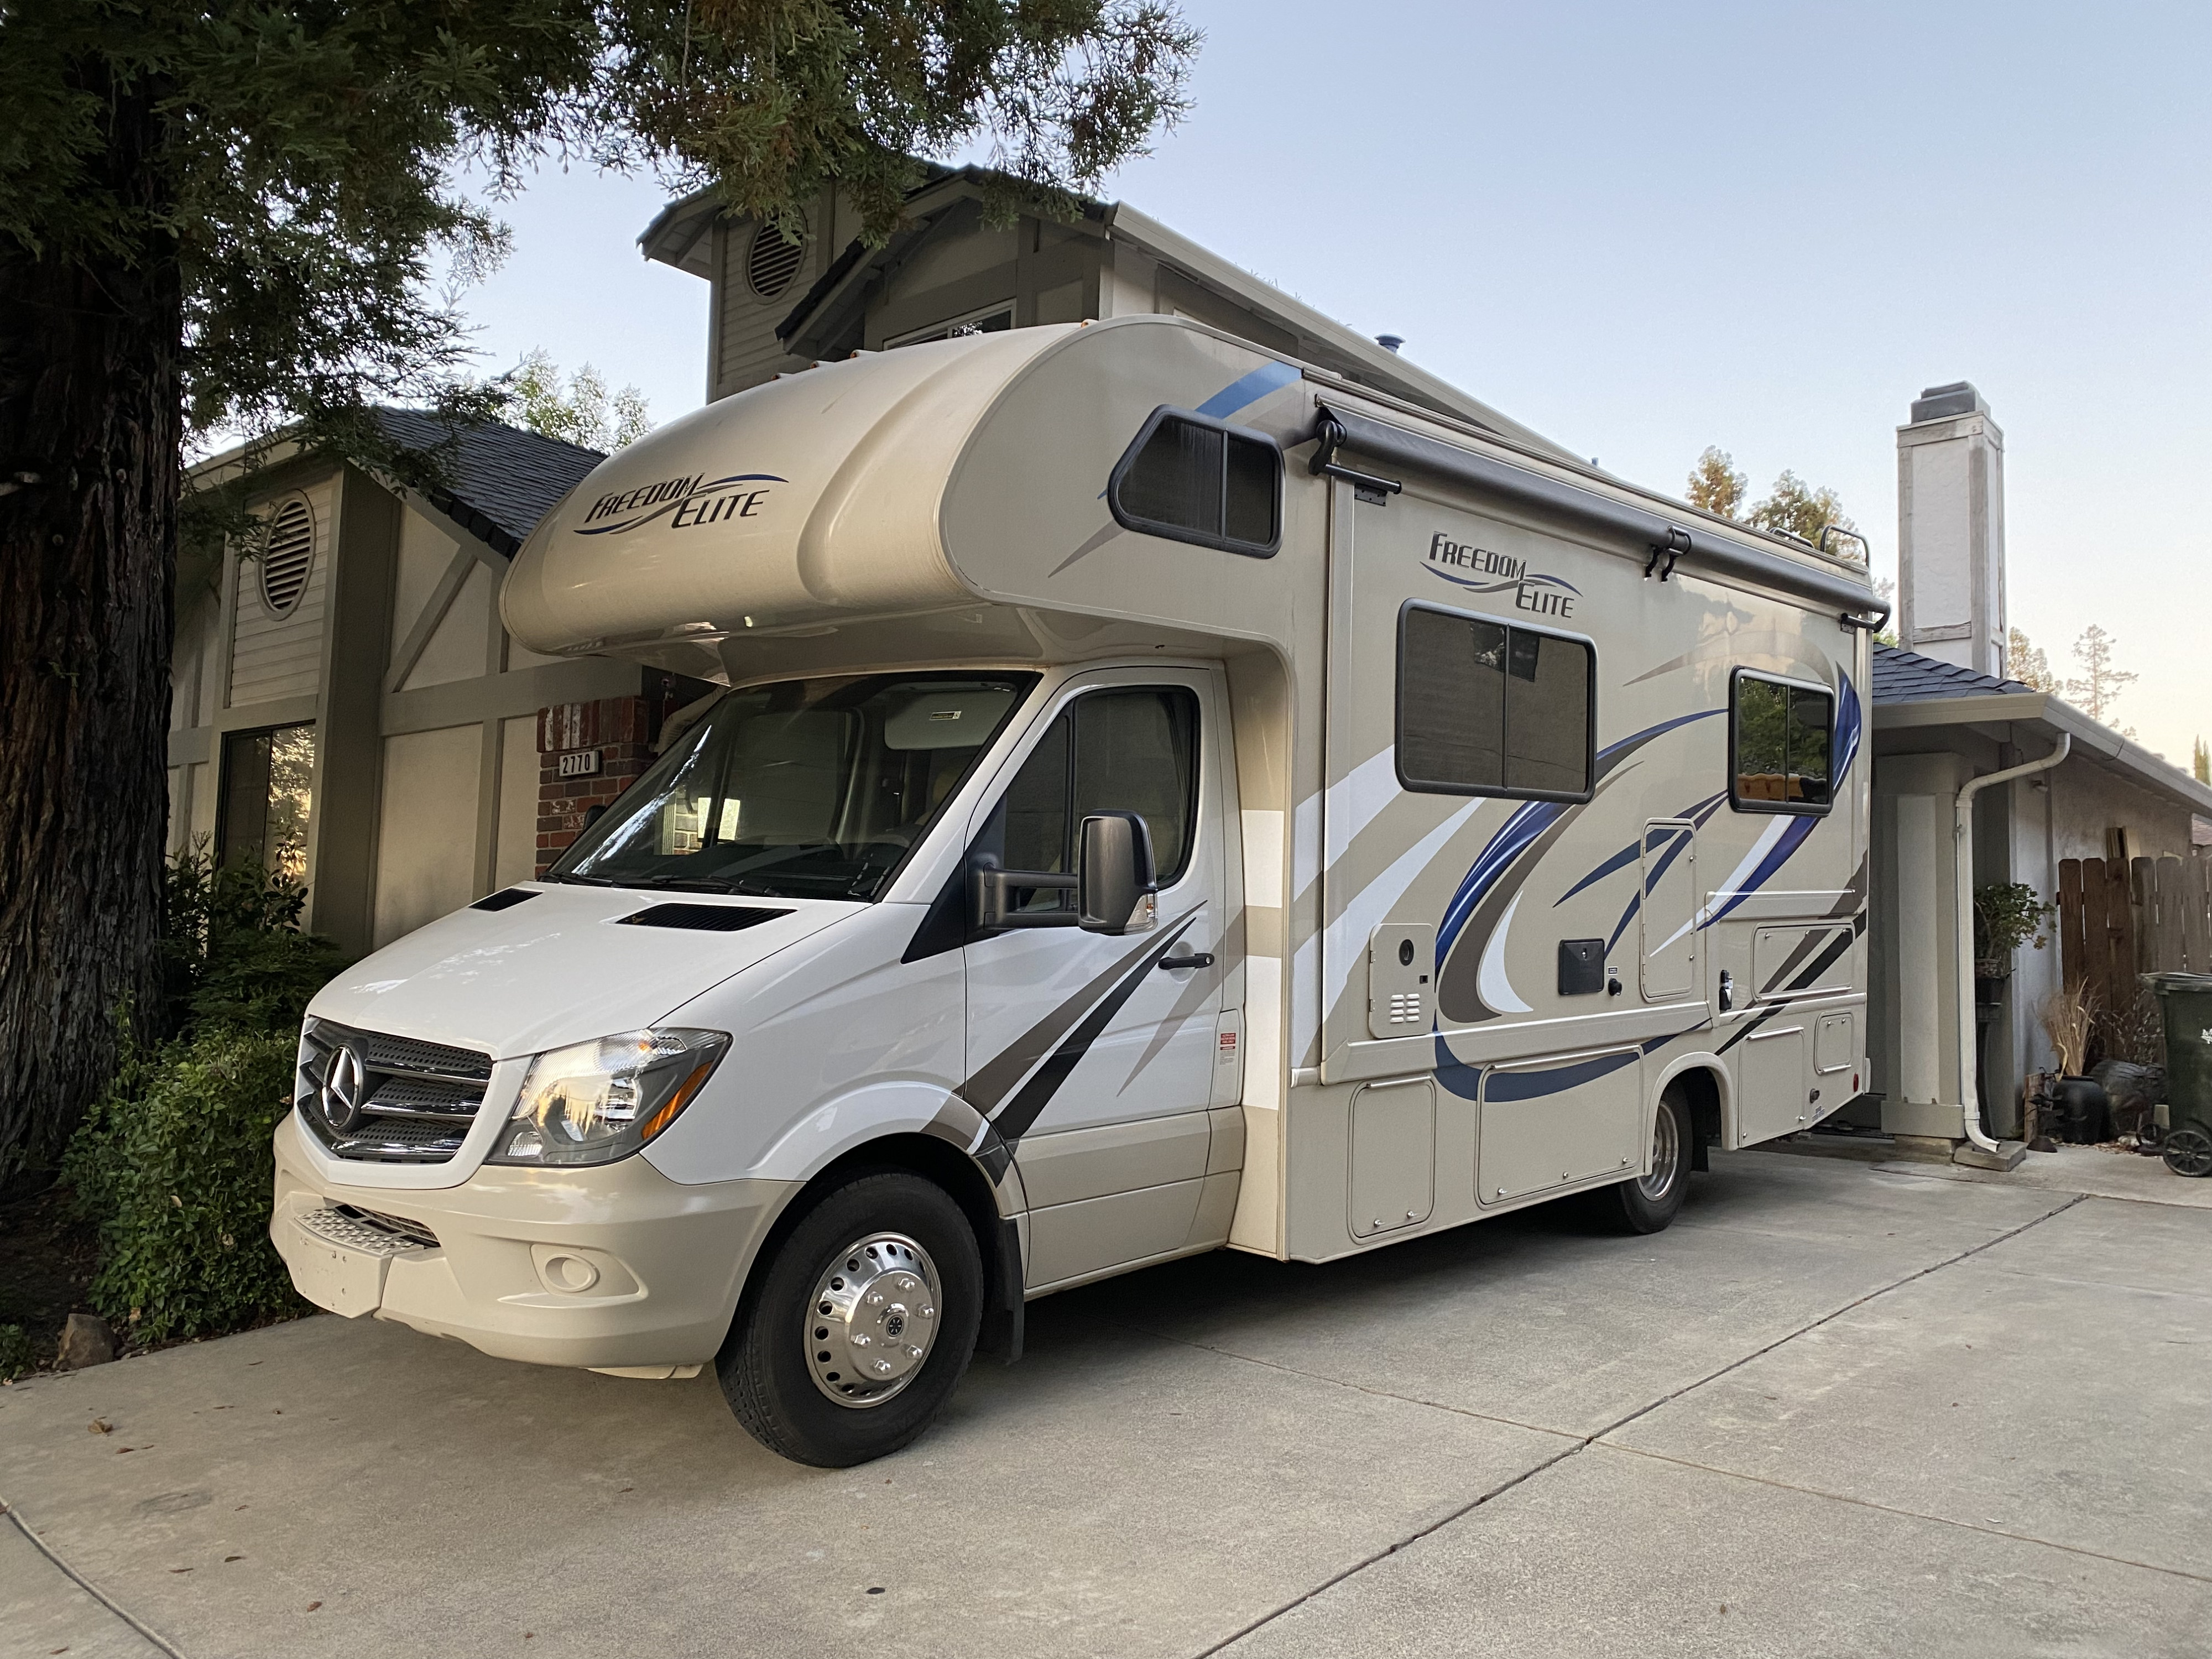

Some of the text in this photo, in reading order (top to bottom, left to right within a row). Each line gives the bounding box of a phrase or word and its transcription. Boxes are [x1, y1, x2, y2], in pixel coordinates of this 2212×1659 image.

[585, 473, 706, 523] FREEDOM
[671, 489, 770, 529] ELITE
[1429, 530, 1526, 581] FREEDOM
[1515, 580, 1574, 618] ELITE
[563, 754, 590, 774] 2770
